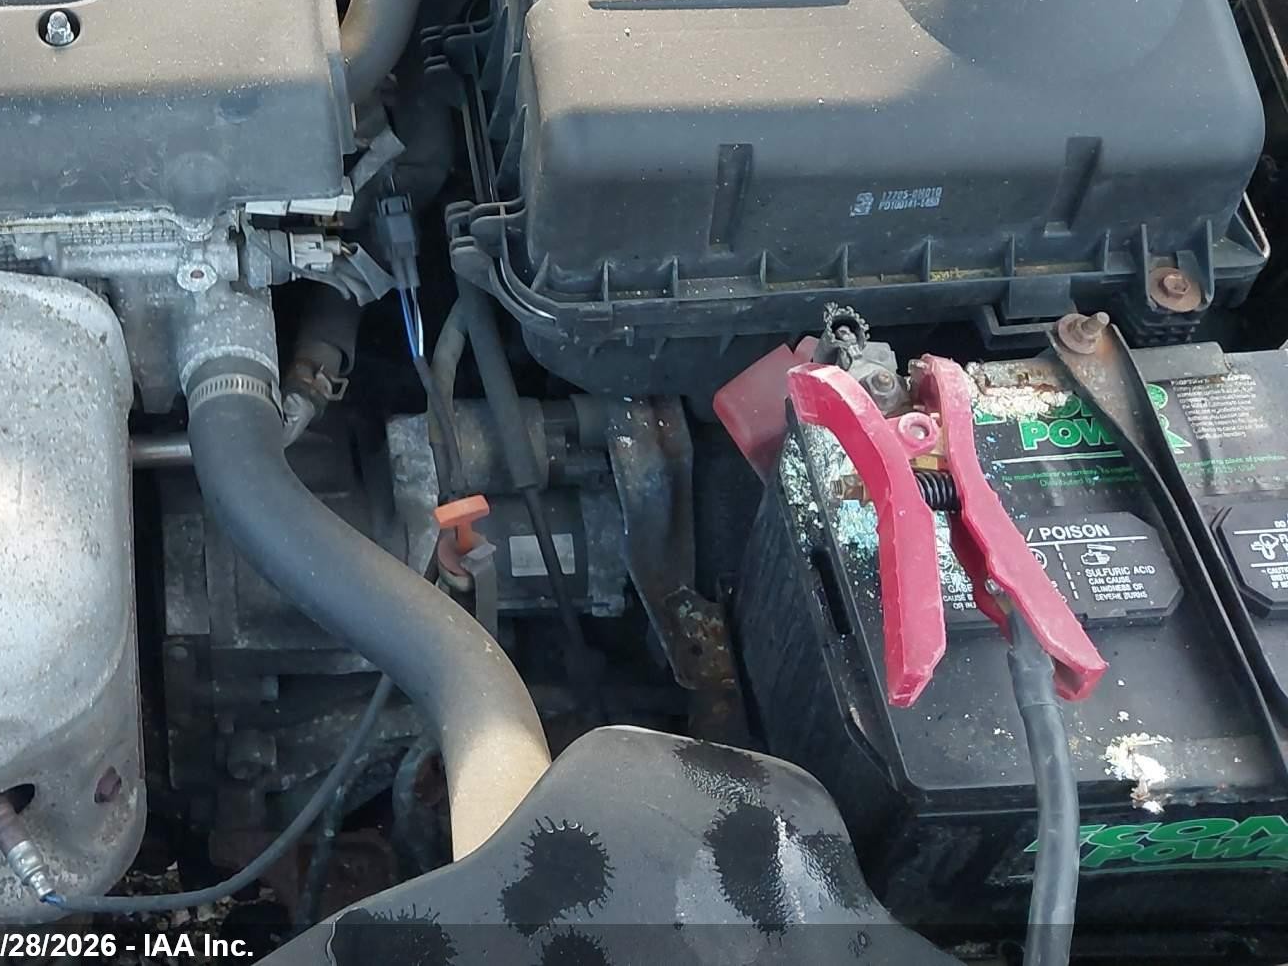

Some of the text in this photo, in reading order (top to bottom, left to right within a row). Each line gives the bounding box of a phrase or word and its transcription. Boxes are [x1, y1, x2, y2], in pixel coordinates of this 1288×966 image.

[1038, 524, 1110, 541] POISON
[1084, 565, 1156, 578] SULFURIC ACID
